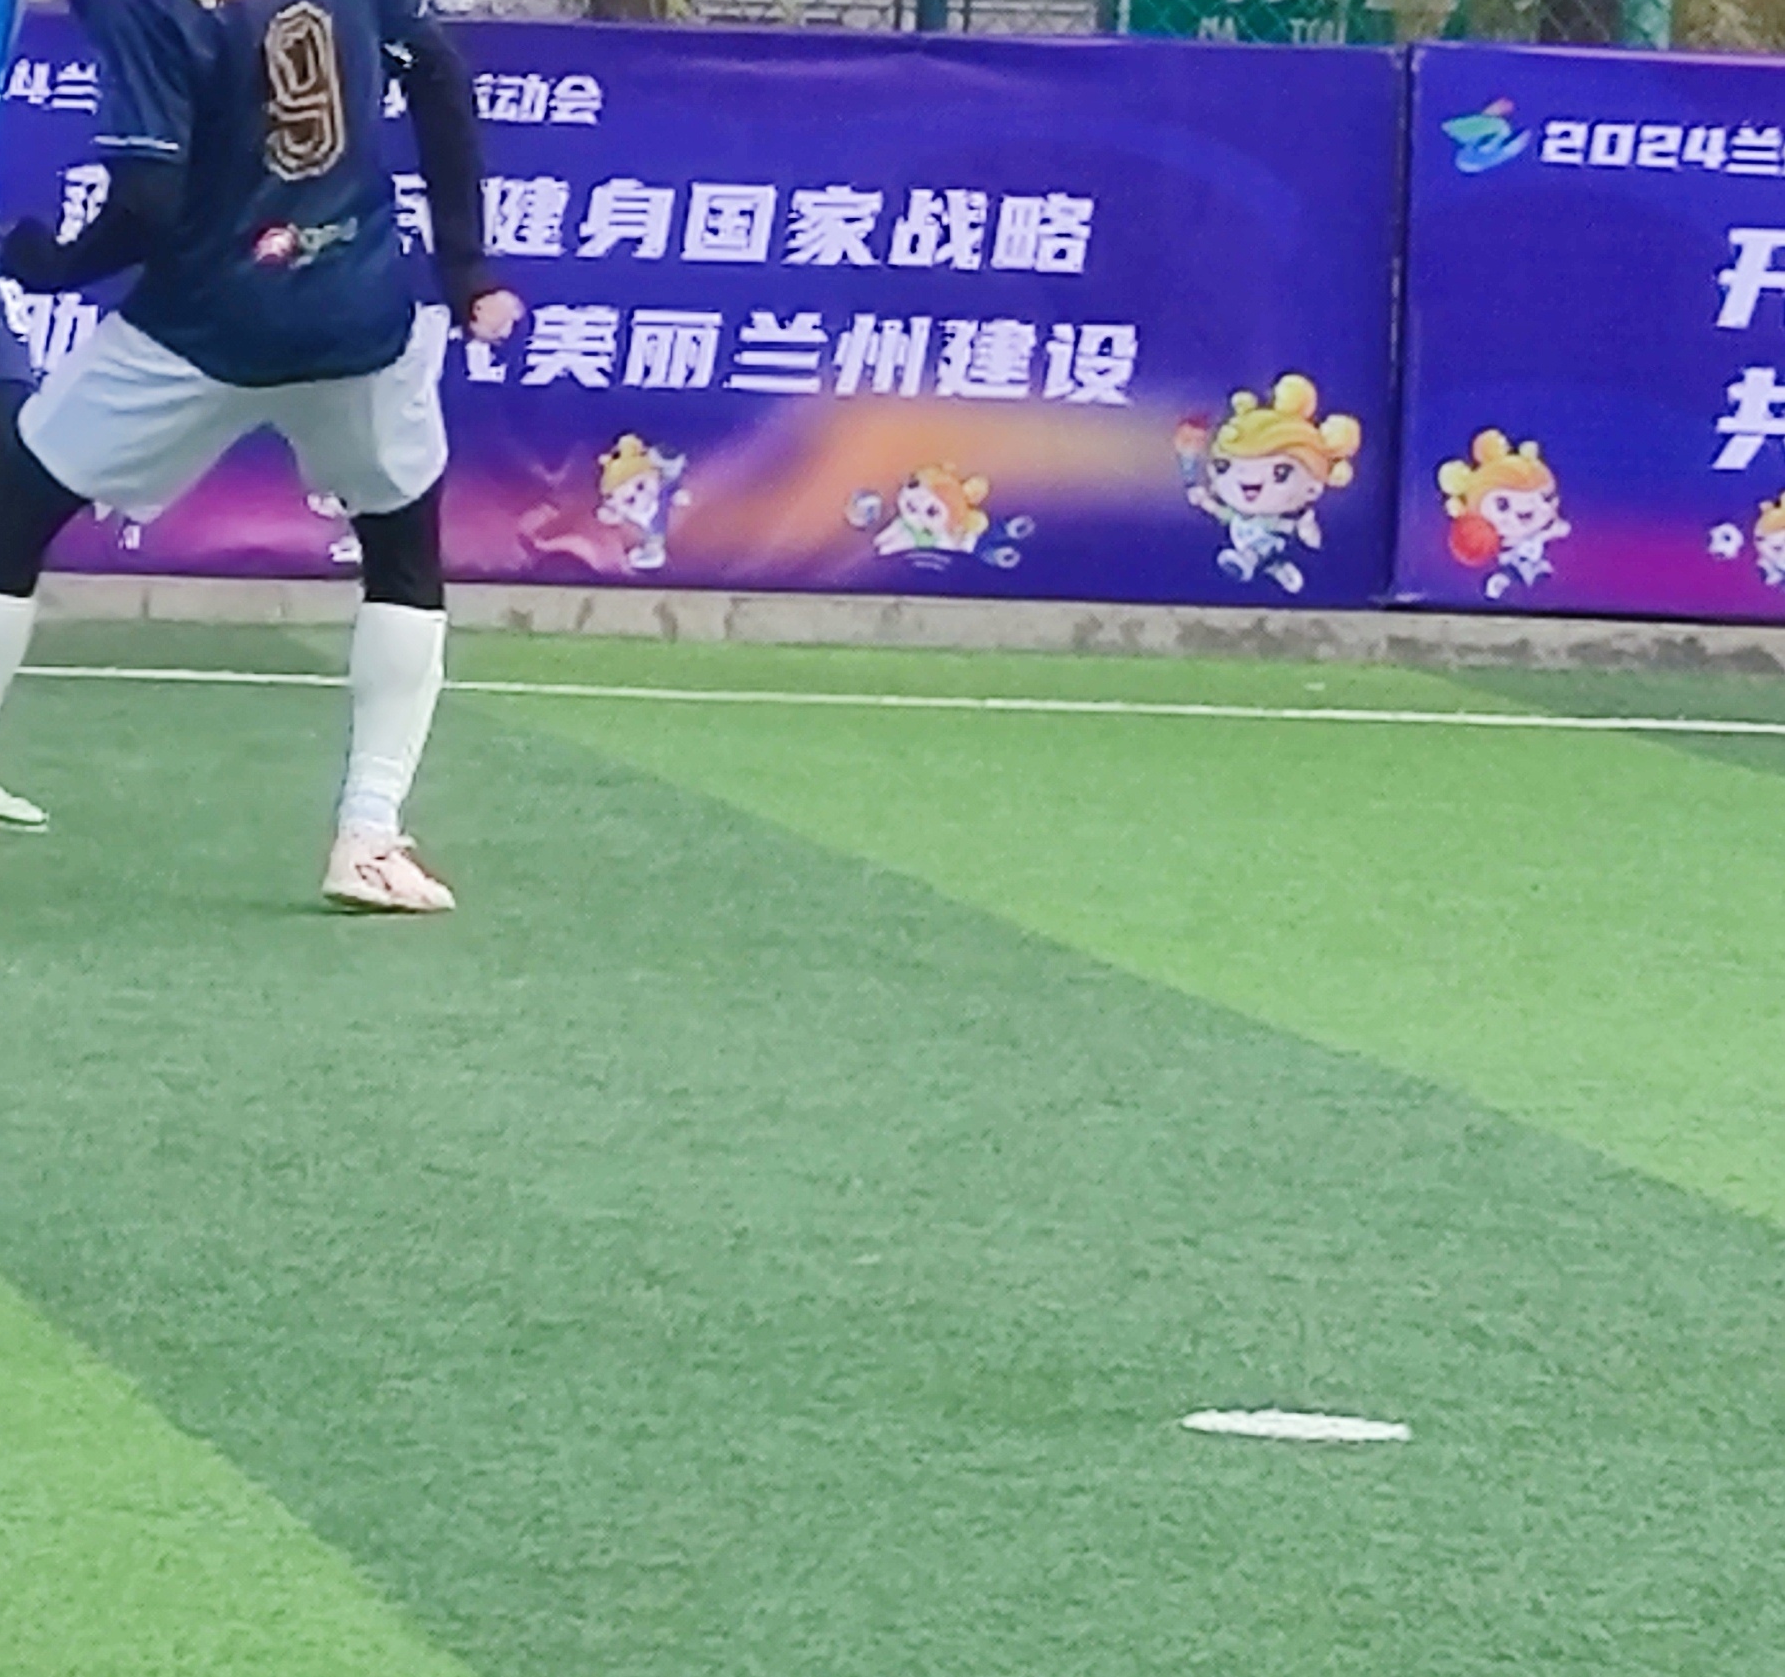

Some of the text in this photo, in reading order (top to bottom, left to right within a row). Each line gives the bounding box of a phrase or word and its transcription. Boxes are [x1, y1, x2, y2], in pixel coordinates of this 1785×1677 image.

[265, 0, 347, 182] 9
[466, 303, 1140, 407] 美丽兰州建设
